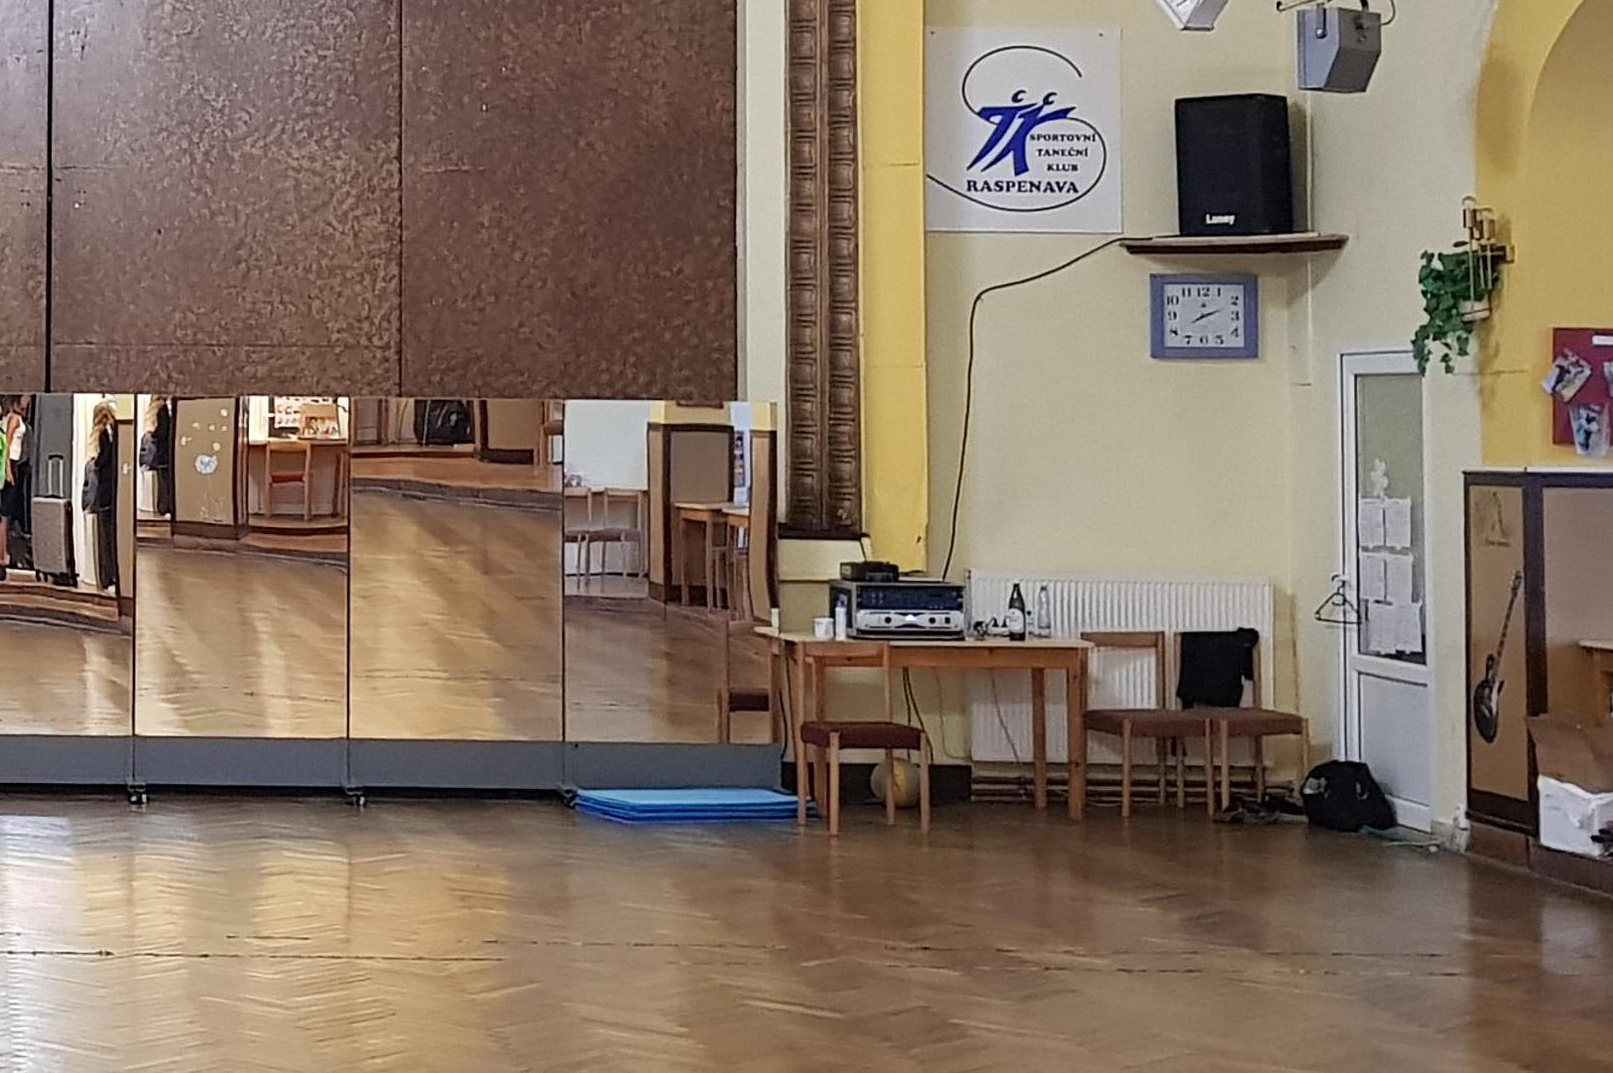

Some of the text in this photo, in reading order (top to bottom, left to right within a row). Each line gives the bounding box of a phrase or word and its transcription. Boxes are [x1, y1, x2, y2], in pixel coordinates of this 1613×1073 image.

[1029, 132, 1096, 142] SPORTOVNÍ
[1036, 146, 1088, 157] TANEČNÍ
[1047, 163, 1079, 171] KLUB
[966, 179, 1079, 193] RASPENAVA
[1182, 287, 1191, 297] 11
[1197, 287, 1210, 297] 12
[1167, 296, 1179, 306] 10
[1231, 295, 1239, 306] 2
[1231, 310, 1239, 321] 3
[1184, 334, 1192, 345] 7
